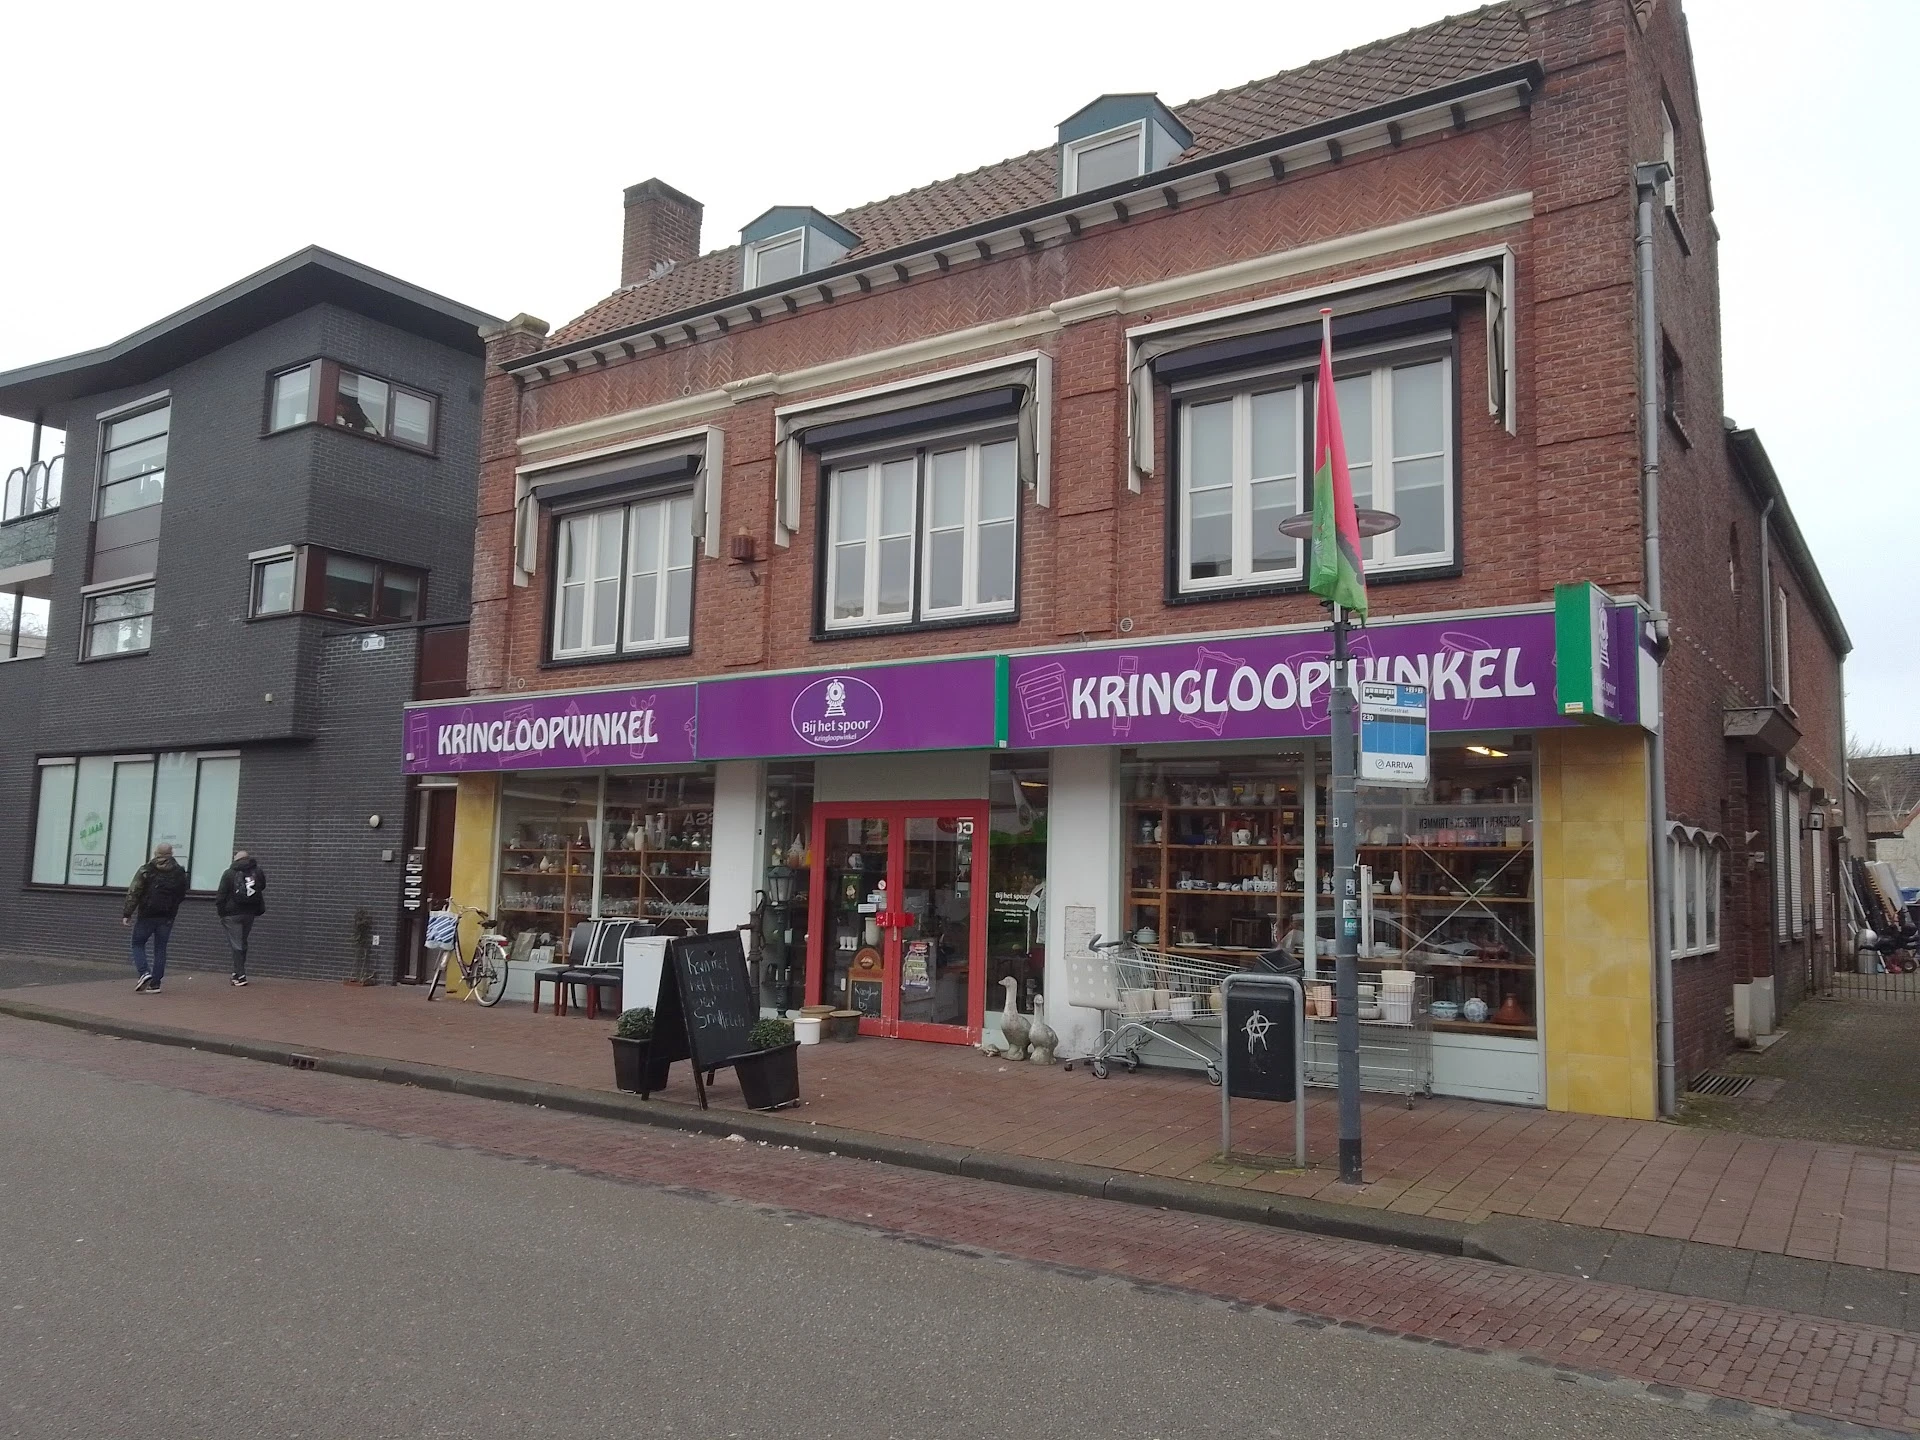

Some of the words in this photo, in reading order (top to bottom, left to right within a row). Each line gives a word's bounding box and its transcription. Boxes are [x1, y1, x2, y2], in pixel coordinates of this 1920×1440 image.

[1380, 706, 1409, 714] Stationsstraat
[1362, 713, 1374, 721] 230
[802, 720, 816, 735] Bij
[818, 719, 836, 732] het
[838, 720, 871, 733] spoor
[438, 709, 659, 755] KRINGLOOPWINKEL
[814, 733, 857, 743] Kringloopwinkel
[1386, 760, 1414, 769] ARRIVA
